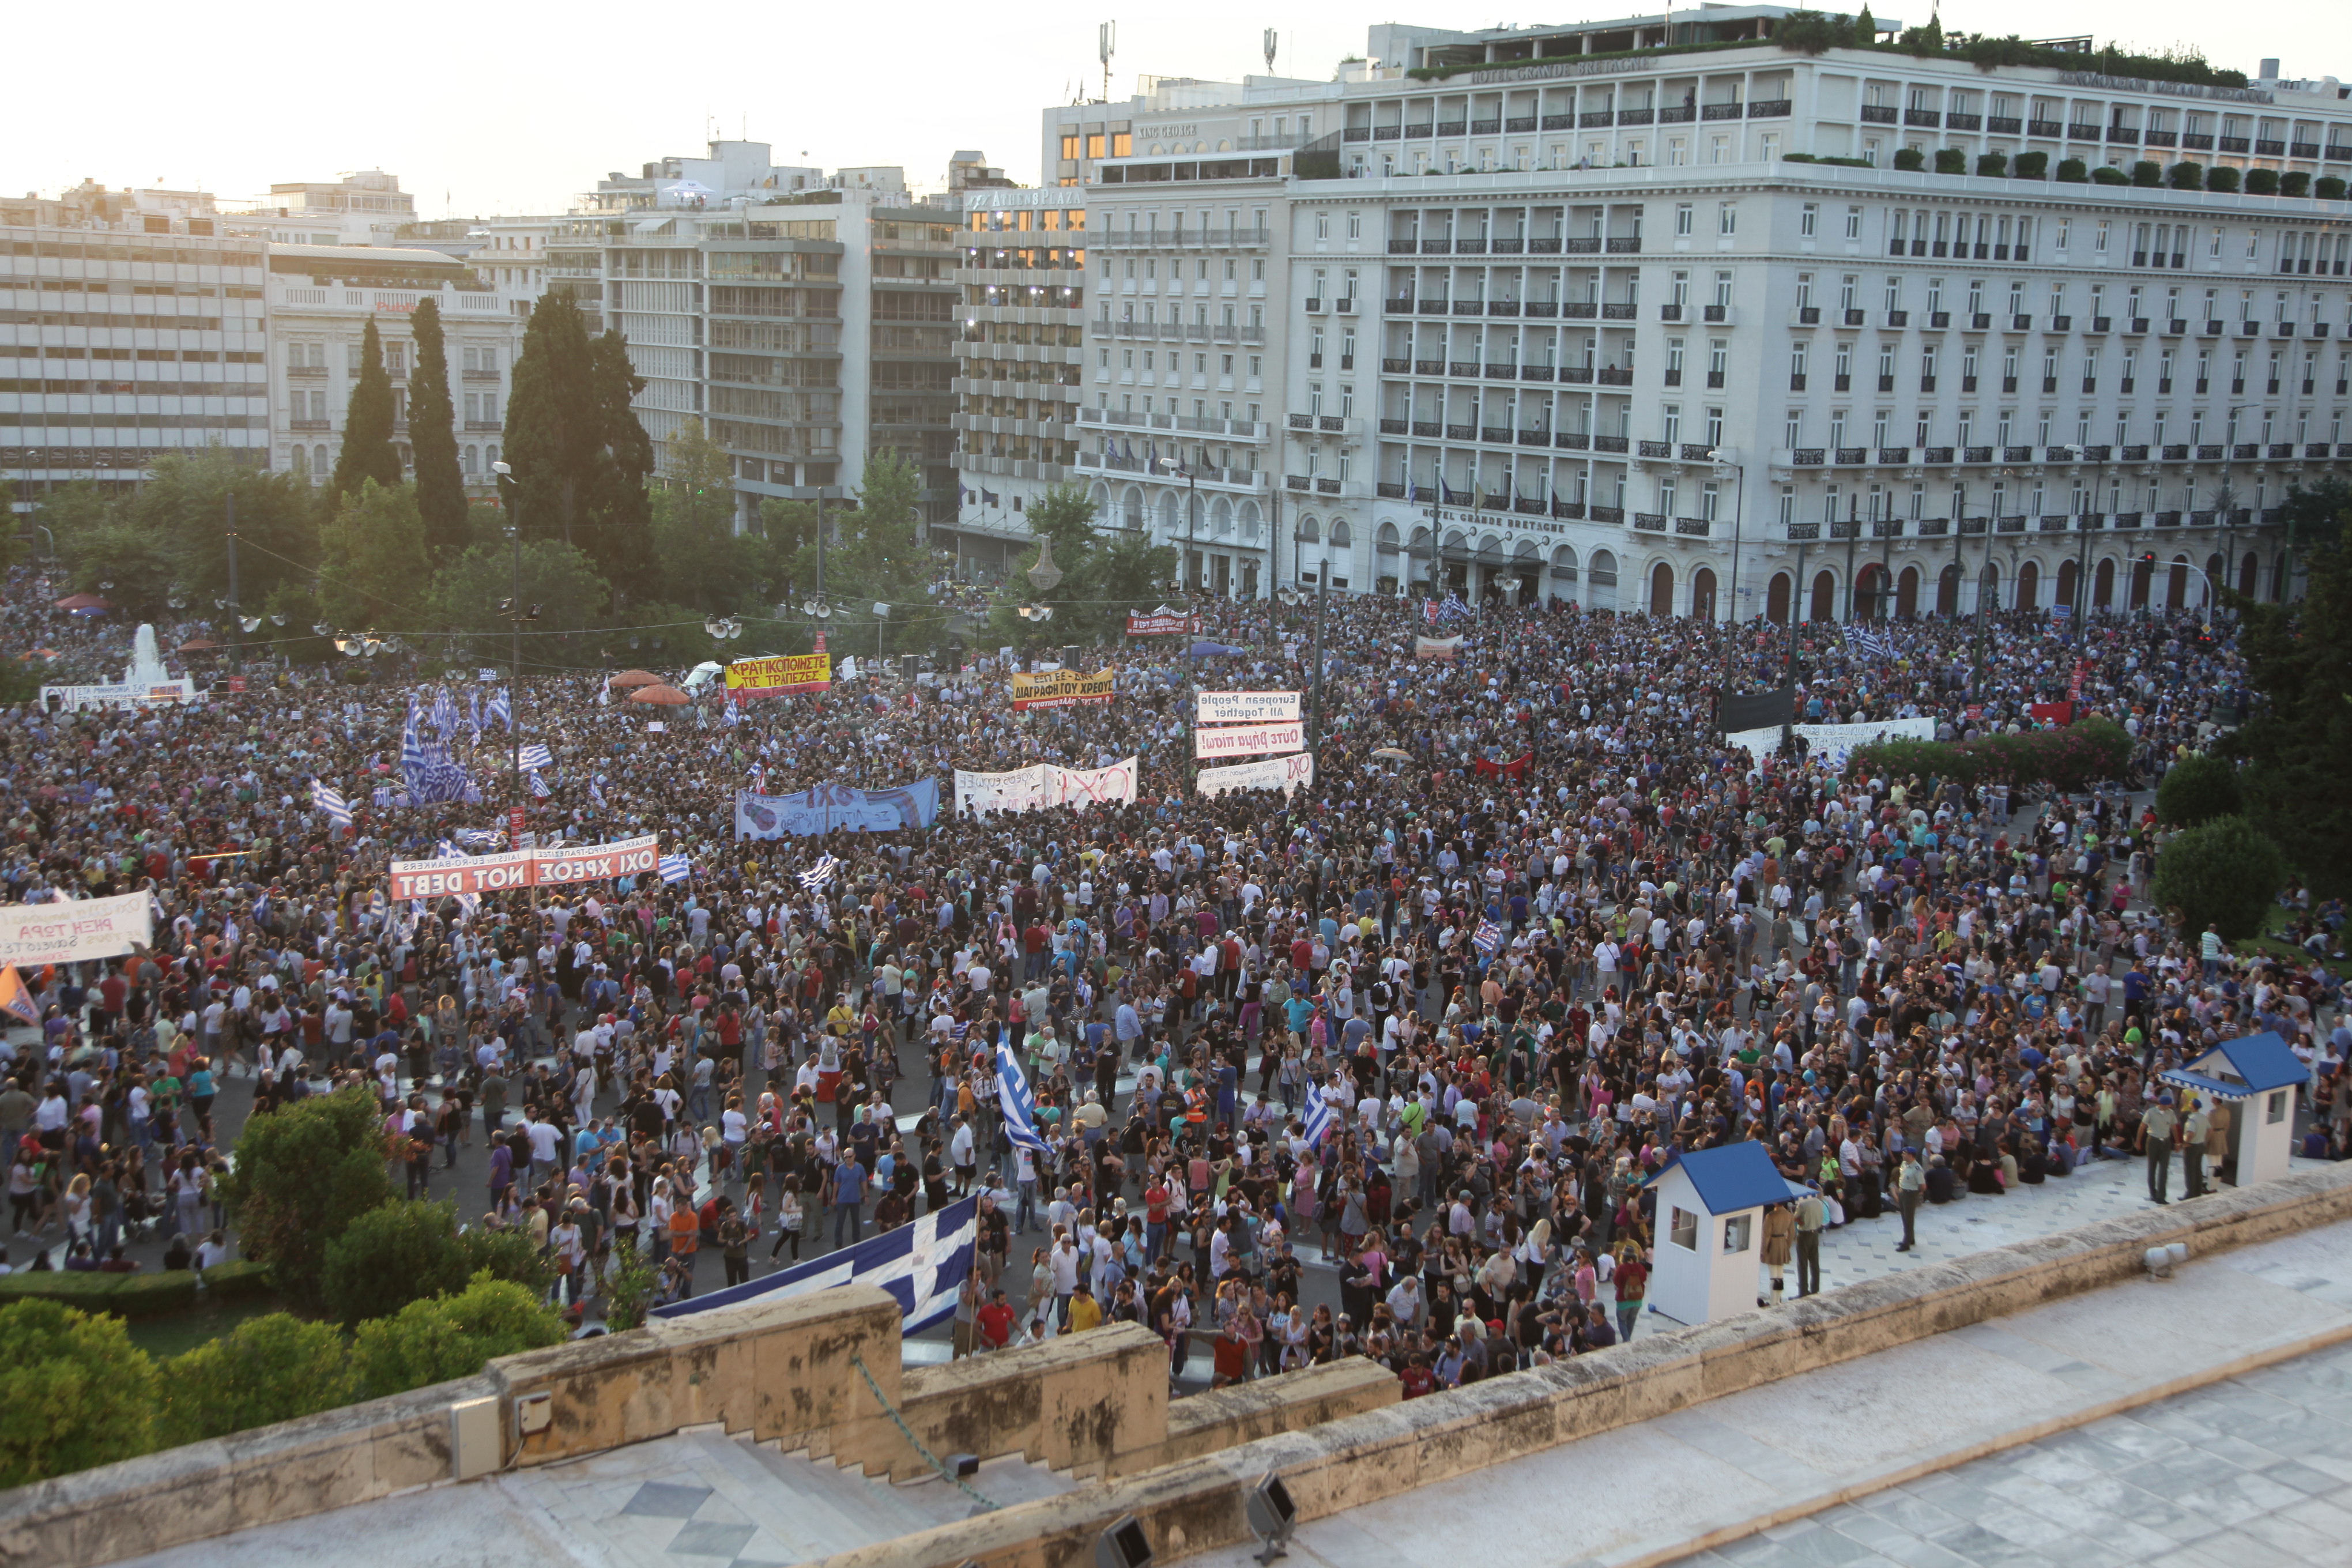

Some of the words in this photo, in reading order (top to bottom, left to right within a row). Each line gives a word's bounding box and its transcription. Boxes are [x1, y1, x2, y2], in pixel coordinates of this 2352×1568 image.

[1471, 69, 1513, 84] HOTEL
[1517, 63, 1571, 80] GRANDE
[1577, 56, 1649, 75] BRETAGNE
[1138, 127, 1159, 139] KING
[1161, 125, 1197, 138] GEORGE
[378, 301, 419, 312] Publi
[1460, 514, 1502, 527] GRANDE
[1507, 518, 1565, 533] BRETAGNE
[730, 655, 827, 676] ΚΡΑΤΙΚΟΠΟΙΗΣΤΕ
[742, 676, 760, 688] ΤΙΣ
[766, 670, 820, 686] ΤΡΑΠΕΖΕΣ
[1034, 674, 1052, 683] ΕΞΩ
[1015, 684, 1058, 698] ΔΙΑΓΡΑΦΗ
[1060, 683, 1077, 694] ΤΟΥ
[1080, 680, 1113, 693] ΧΡΕΟΥΣ
